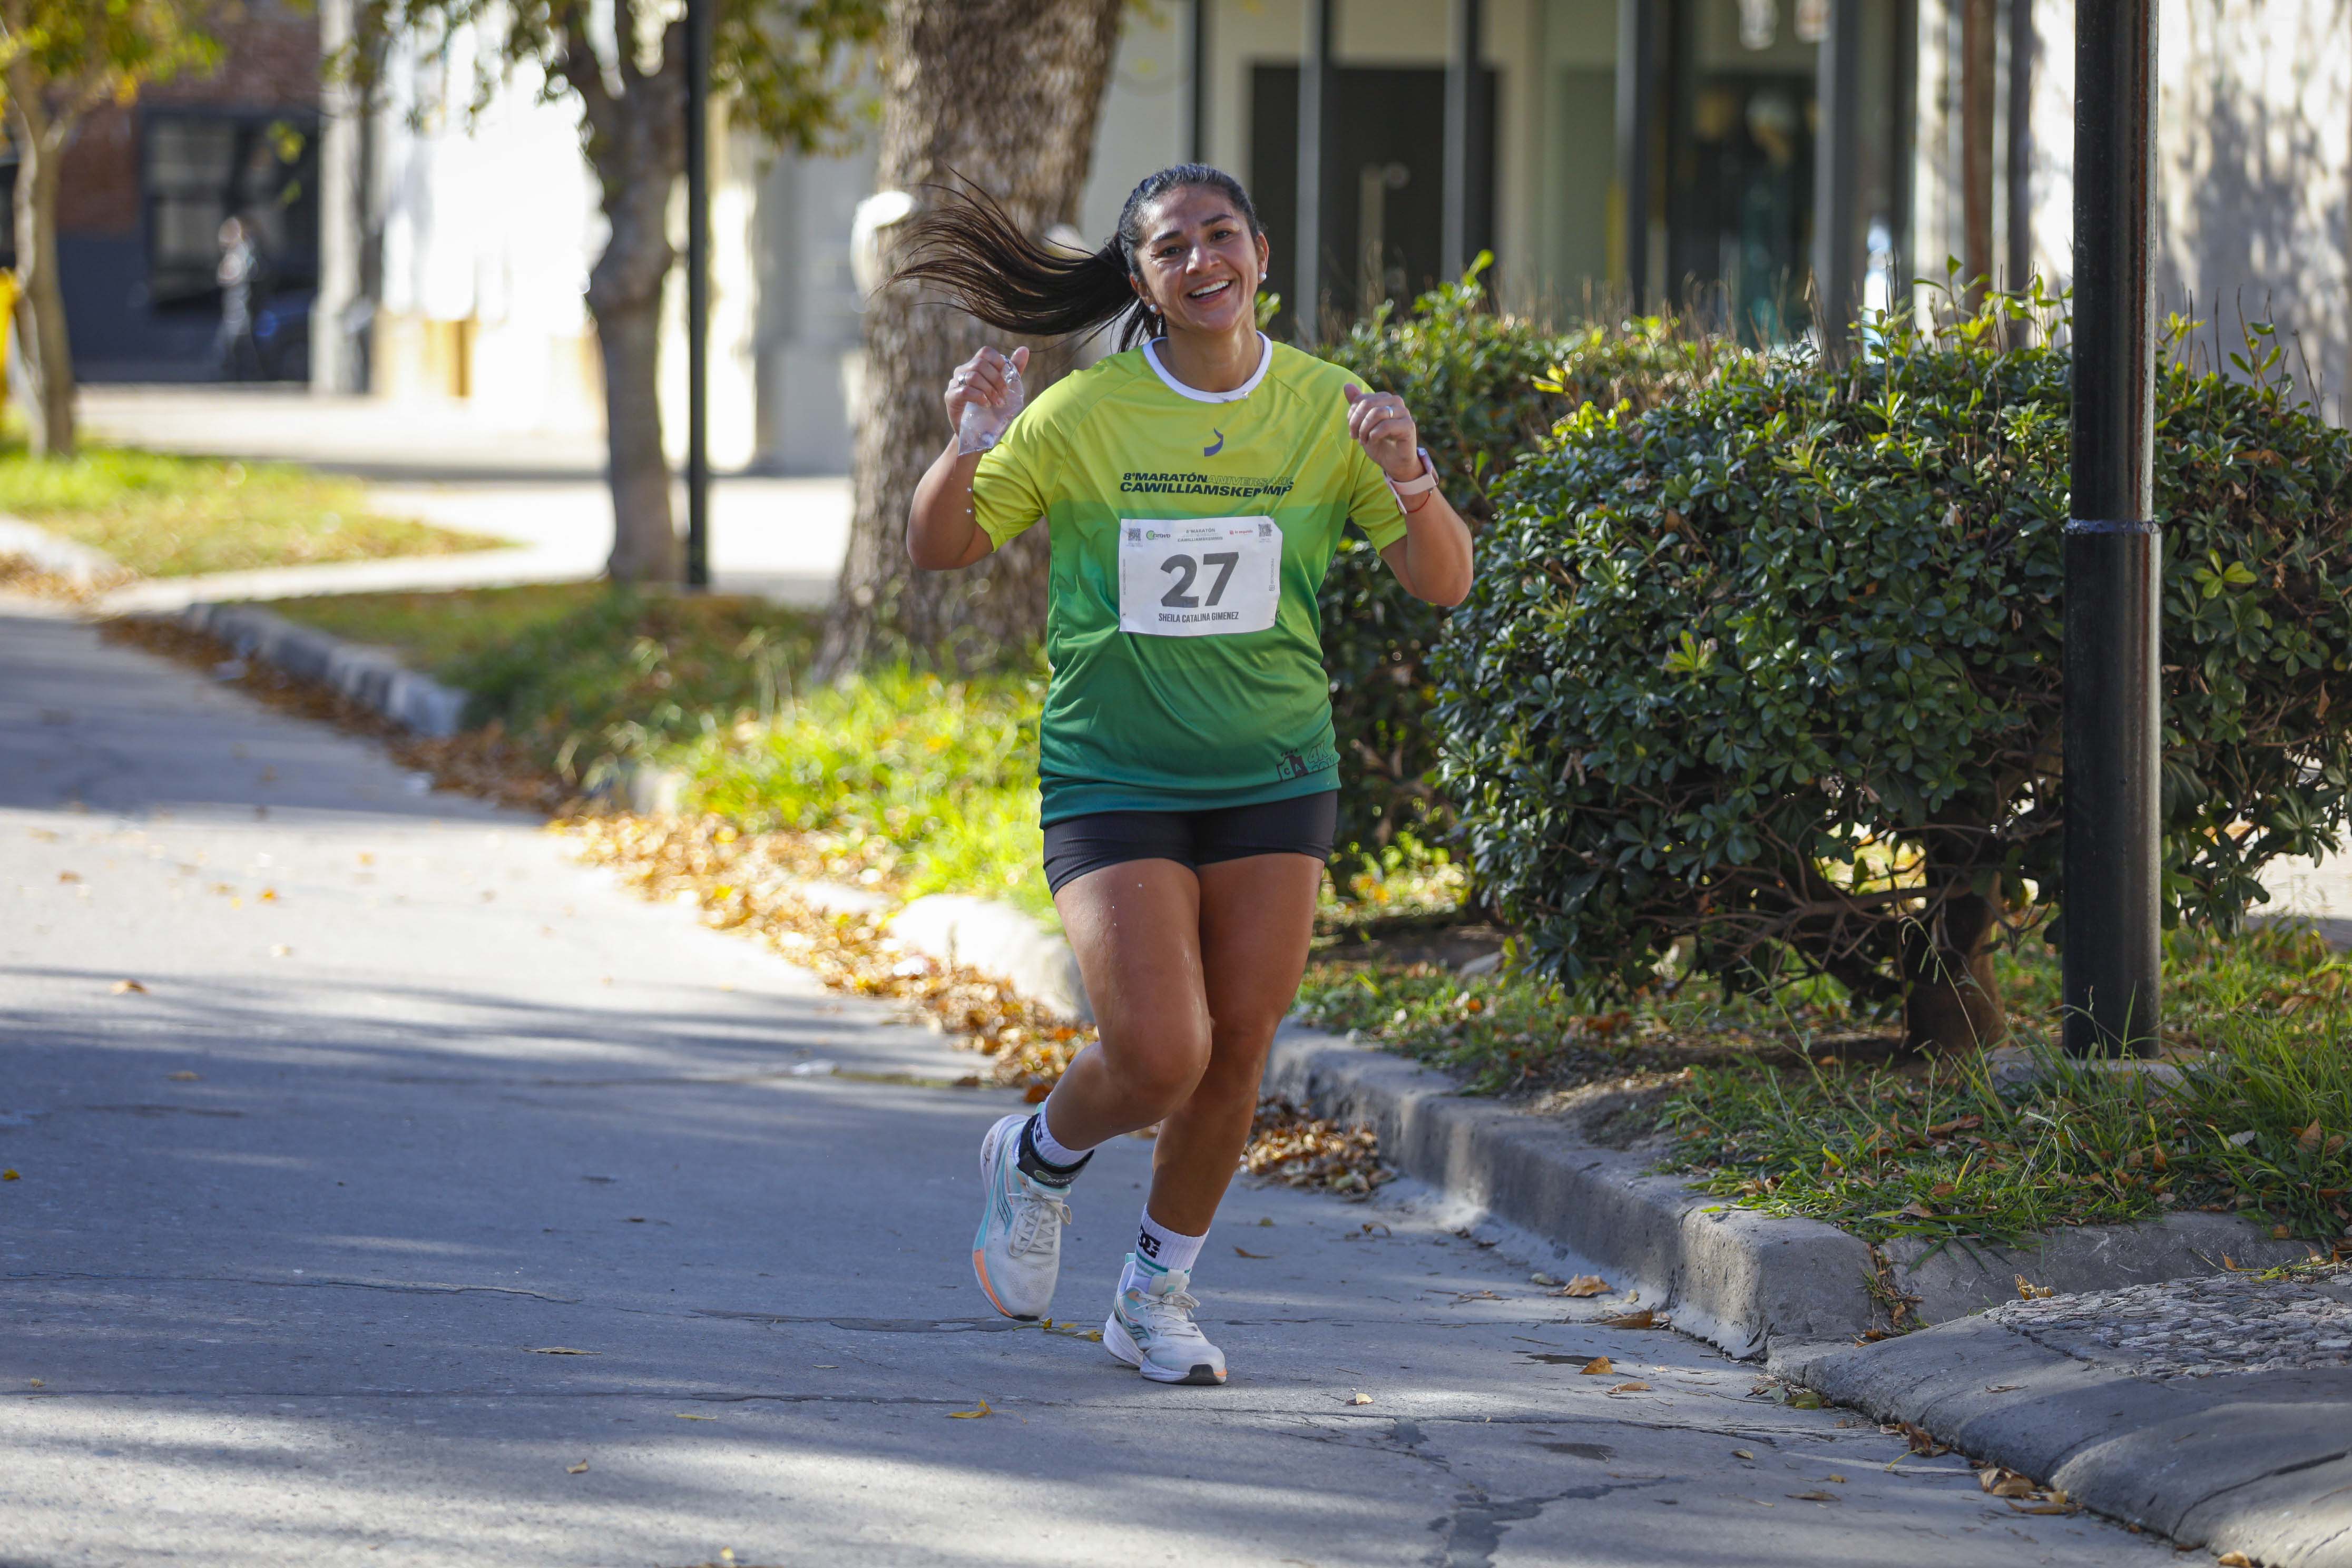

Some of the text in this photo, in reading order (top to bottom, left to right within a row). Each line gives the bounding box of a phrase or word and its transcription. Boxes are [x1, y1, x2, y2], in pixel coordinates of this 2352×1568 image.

[1160, 552, 1239, 608] 27
[1159, 612, 1239, 623] SHEILA CATALINA GIMENEZ
